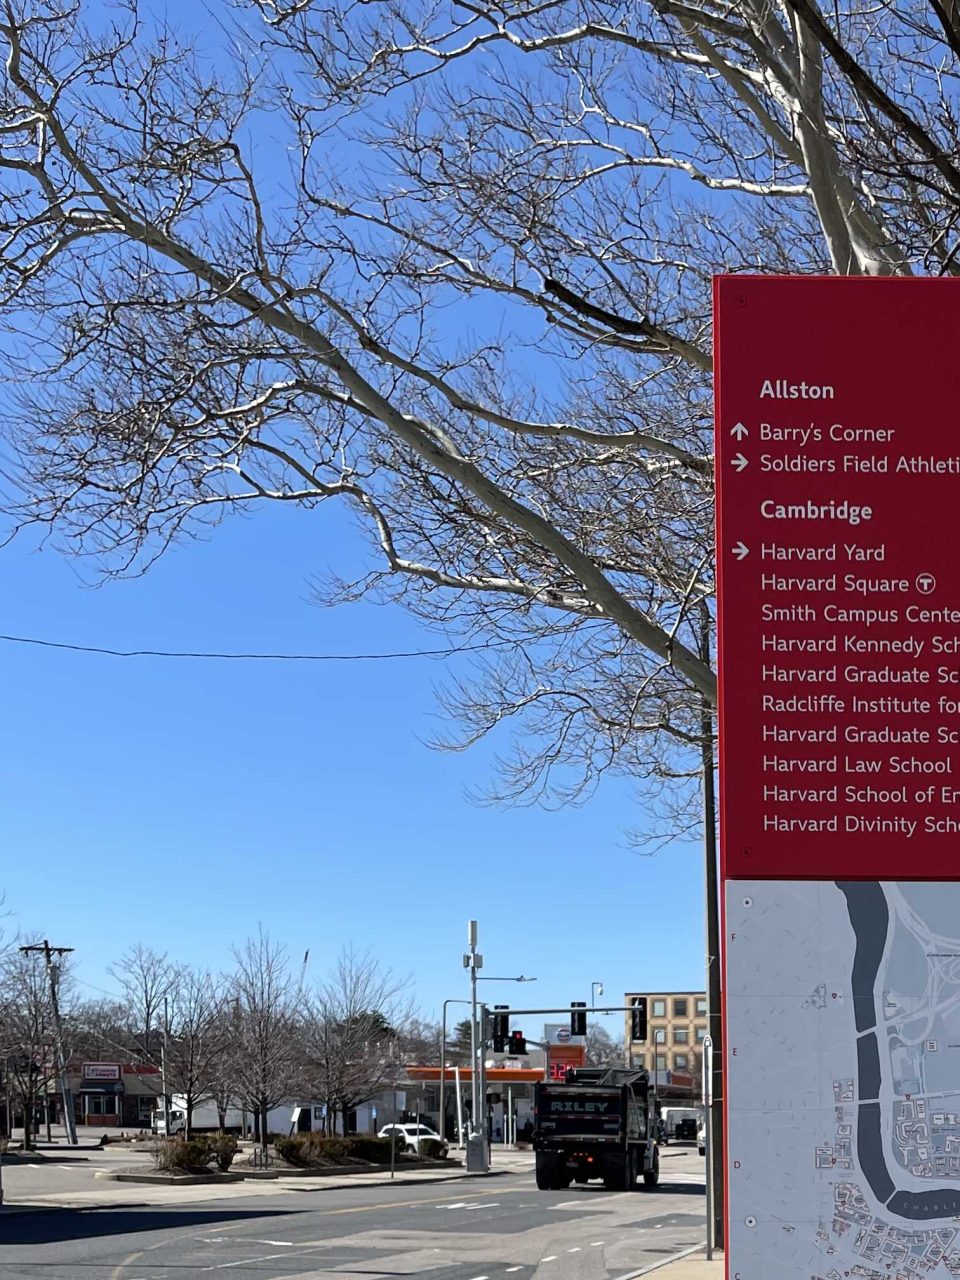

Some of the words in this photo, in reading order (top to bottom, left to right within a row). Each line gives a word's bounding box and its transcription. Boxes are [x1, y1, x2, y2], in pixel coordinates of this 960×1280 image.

[759, 379, 834, 400] Allston
[760, 422, 822, 447] Barry's
[829, 423, 896, 442] Corner
[760, 454, 836, 473] Soldiers
[843, 455, 888, 473] Field
[760, 499, 873, 526] Cambridge
[761, 542, 836, 561] Harvard
[843, 543, 885, 562] Yard
[761, 573, 836, 592] Harvard
[844, 574, 910, 597] Square
[761, 603, 816, 622] Smith
[823, 604, 899, 627] Campus
[762, 634, 837, 653] Harvard
[844, 634, 925, 659] Kennedy
[762, 664, 837, 682] Harvard
[844, 665, 930, 683] Graduate
[762, 694, 845, 713] Radcliffe
[852, 695, 931, 714] Institute
[763, 724, 837, 743] Harvard
[844, 725, 930, 744] Graduate
[763, 755, 837, 773] Harvard
[845, 755, 882, 773] Law
[889, 756, 952, 773] School
[763, 784, 837, 802] Harvard
[845, 785, 908, 803] School
[914, 785, 936, 803] of
[763, 814, 838, 832] Harvard
[845, 815, 918, 838] Divinity
[731, 933, 736, 942] F
[732, 1047, 737, 1057] E
[551, 1101, 609, 1113] RILEY
[733, 1160, 741, 1169] D
[734, 1272, 741, 1280] C
